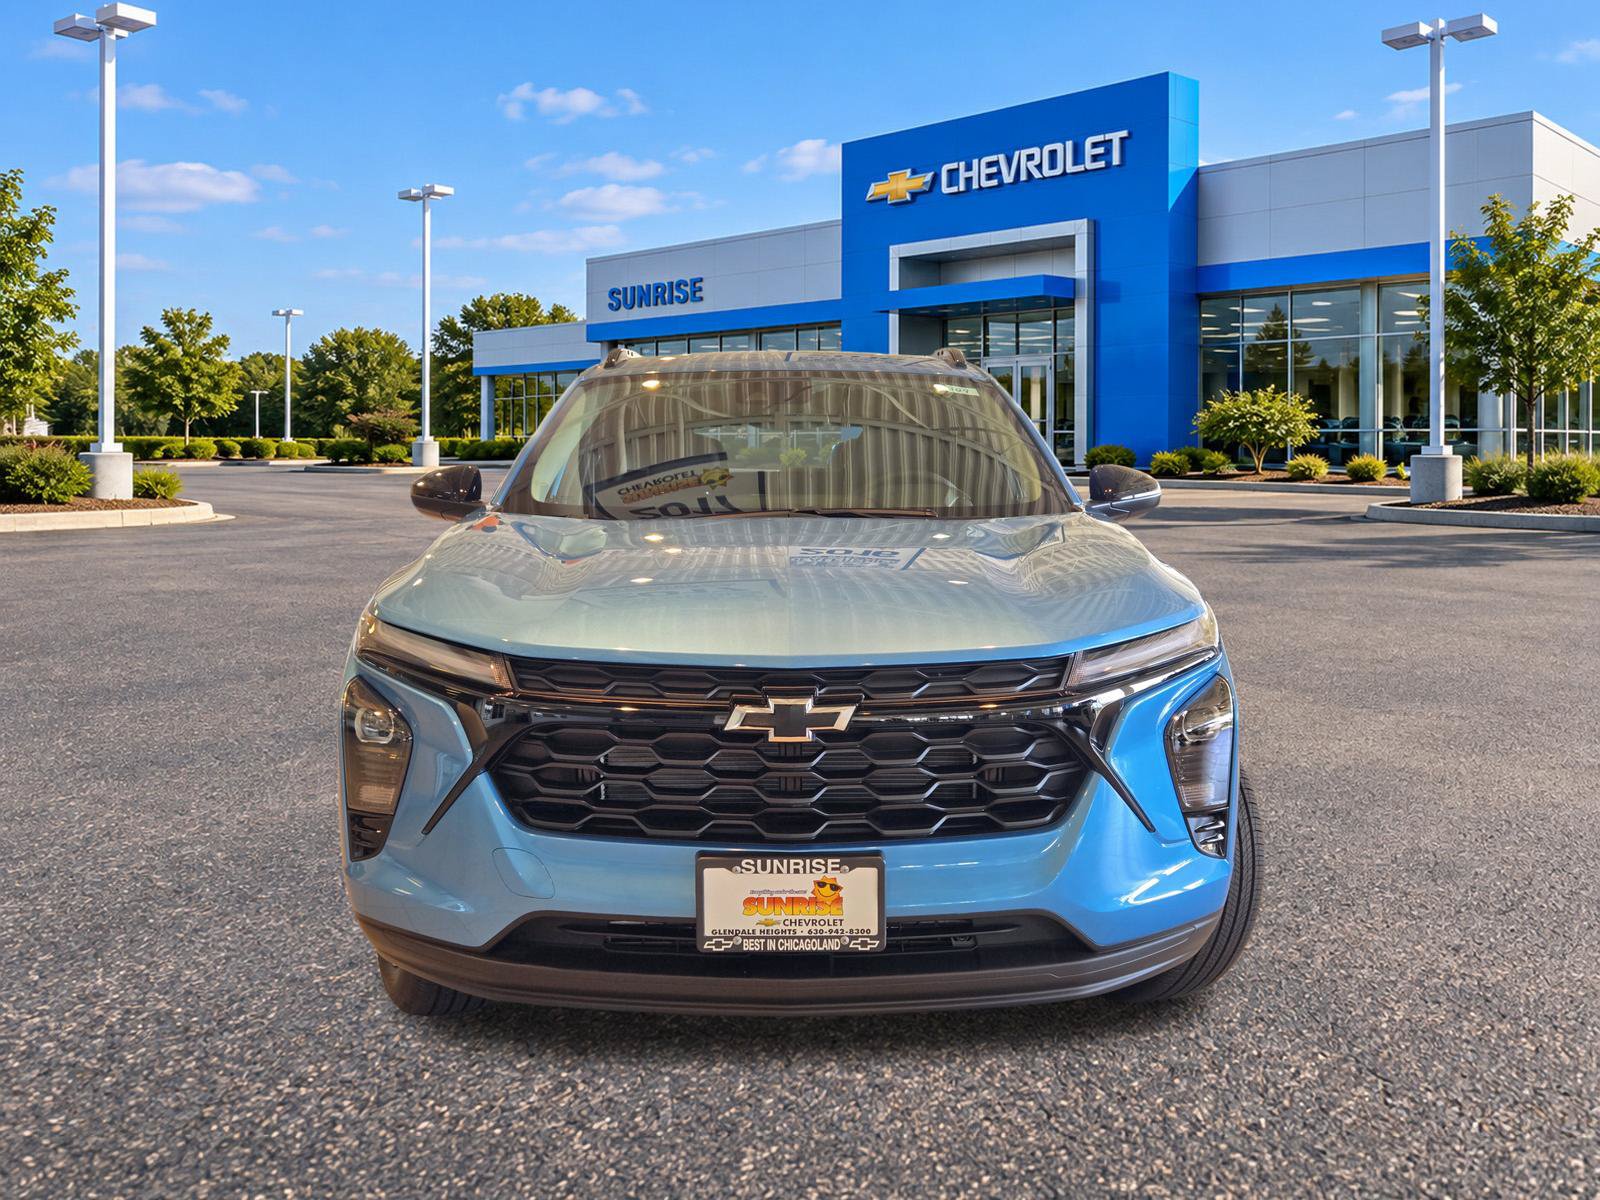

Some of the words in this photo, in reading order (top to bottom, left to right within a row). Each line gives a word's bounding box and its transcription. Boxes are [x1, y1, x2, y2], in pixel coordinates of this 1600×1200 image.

[941, 130, 1129, 195] CHEVROLET
[608, 277, 704, 312] SUNRISE
[741, 858, 841, 874] SUNRISE
[742, 896, 844, 916] SUNRISE
[783, 918, 844, 927] CHEVROLET
[743, 938, 767, 951] BEST
[767, 938, 778, 950] IN
[778, 938, 841, 951] CHICAGOLAND
